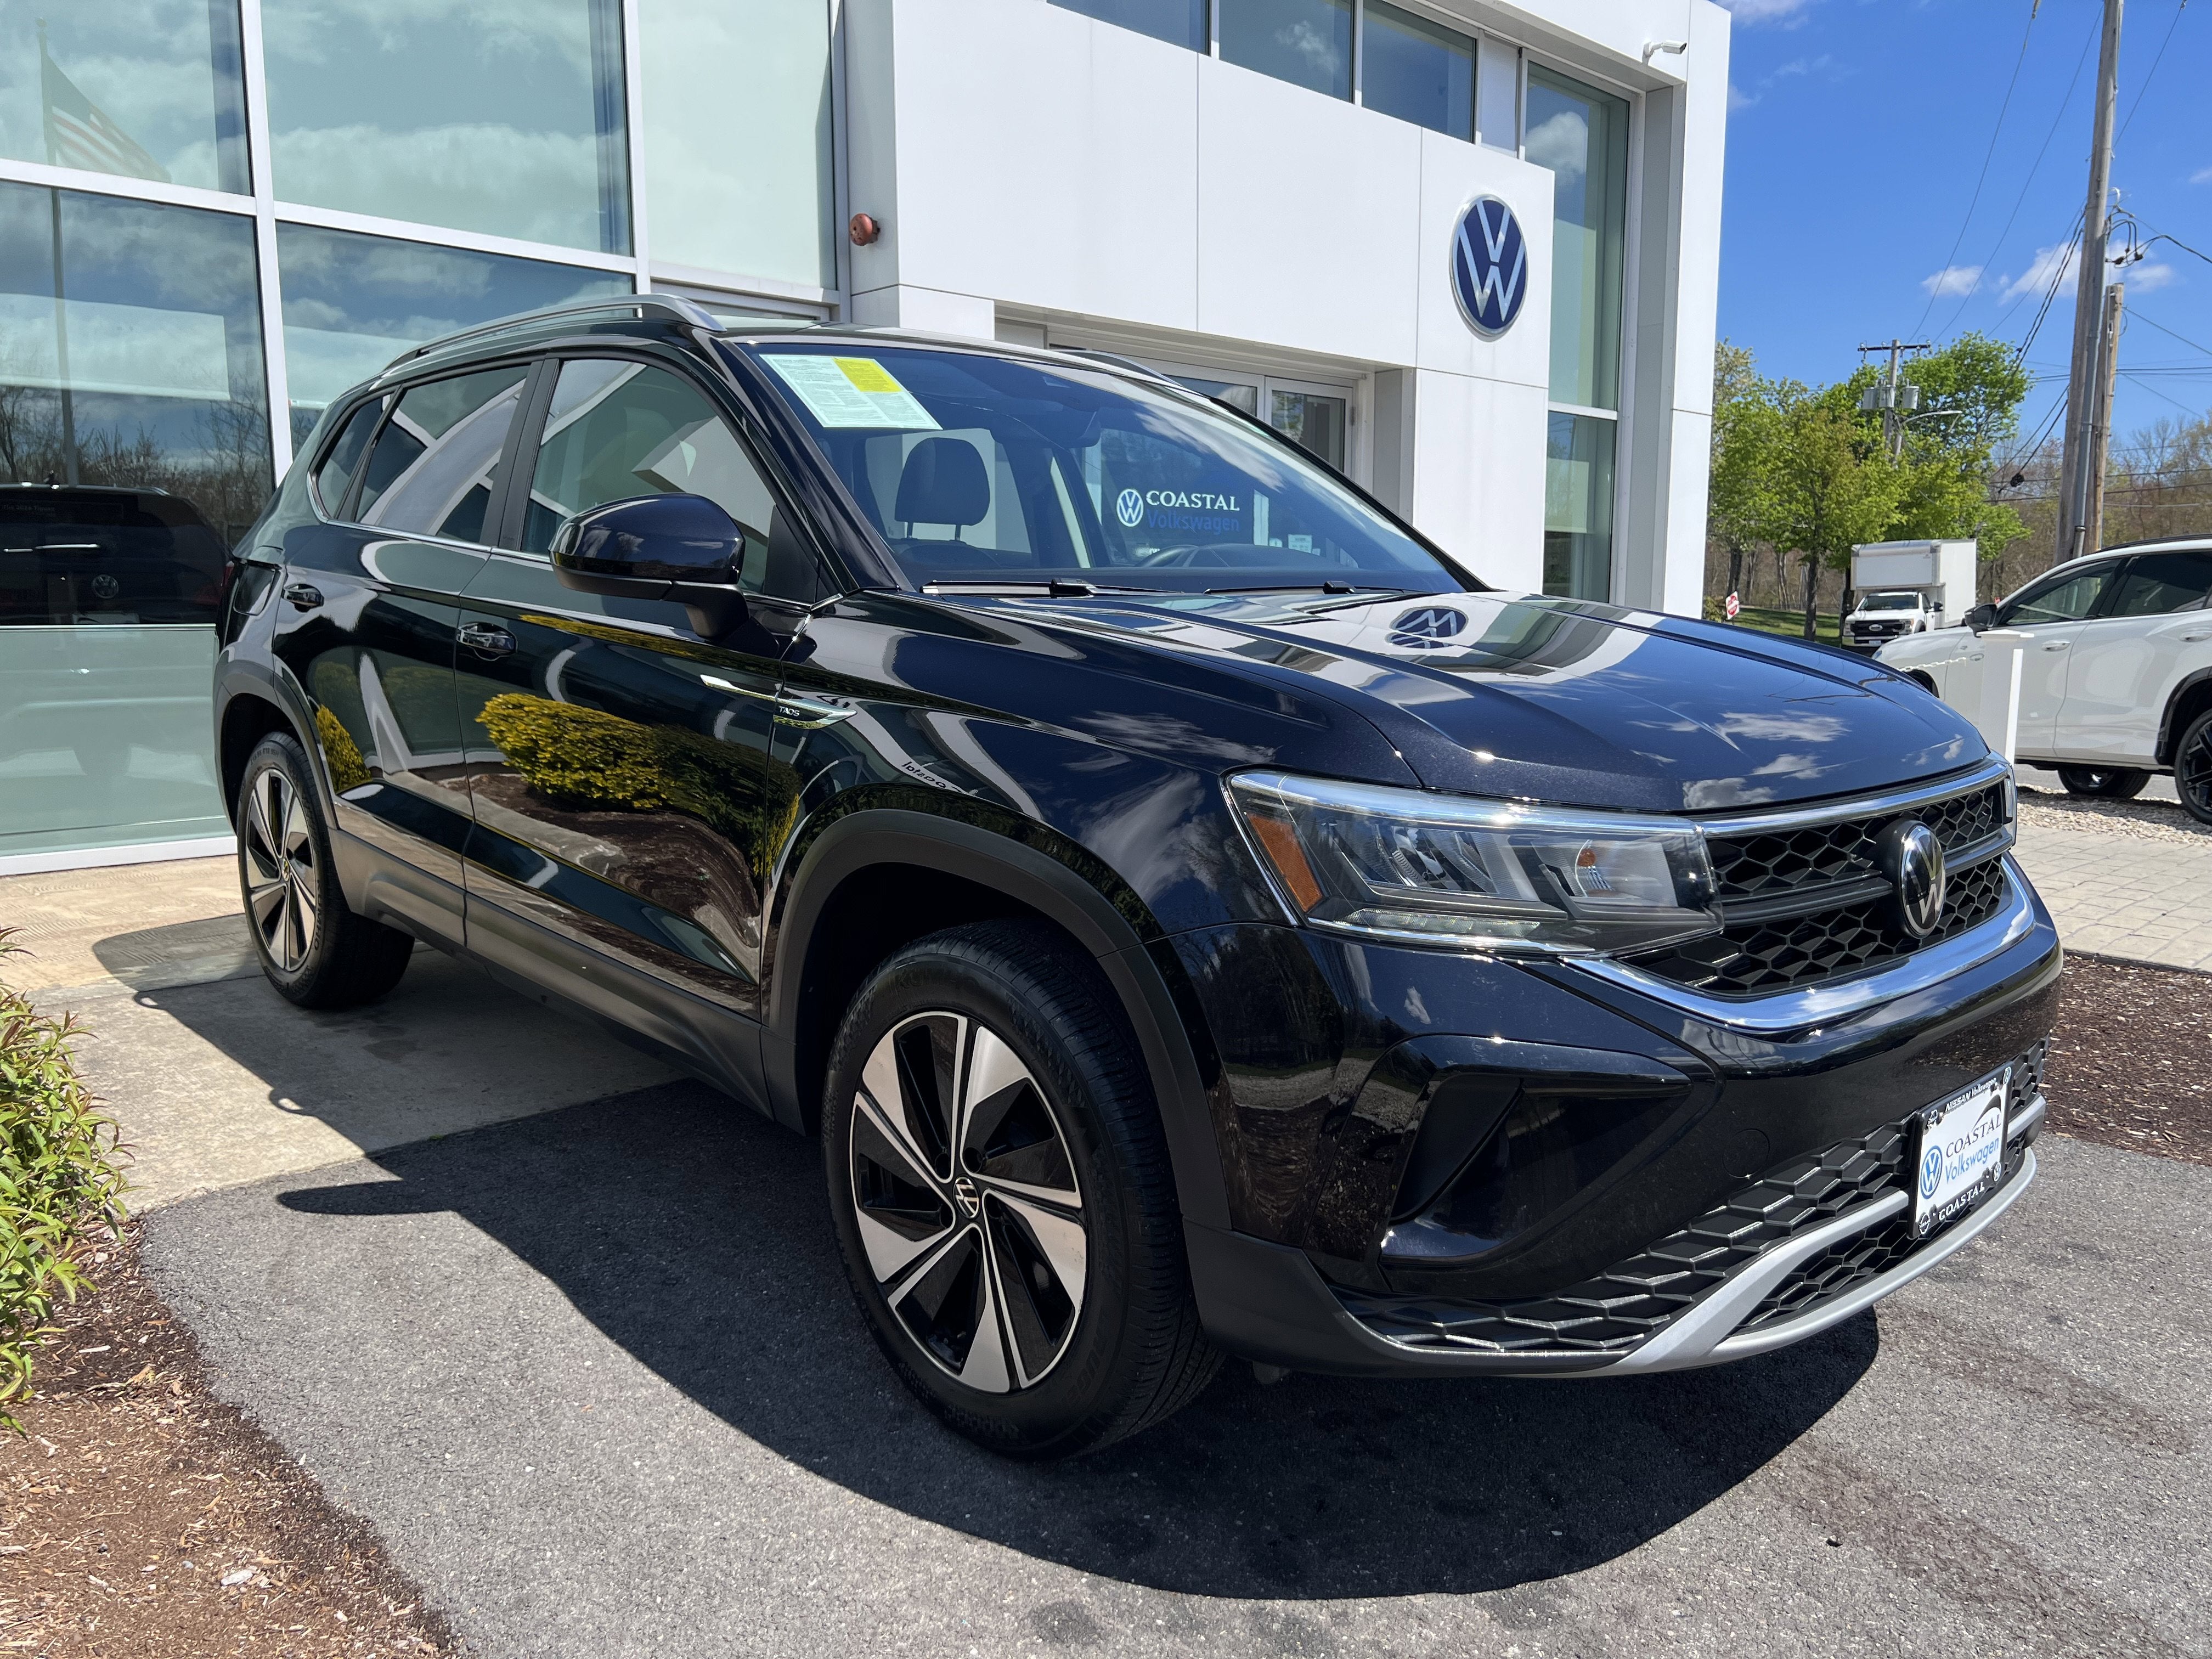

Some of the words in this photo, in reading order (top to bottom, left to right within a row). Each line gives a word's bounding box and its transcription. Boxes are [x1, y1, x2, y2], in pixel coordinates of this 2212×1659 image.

[1449, 194, 1528, 334] VW
[1116, 488, 1144, 527] VW
[1146, 490, 1240, 511] COASTAL
[1147, 509, 1239, 535] Volkswagen
[779, 706, 800, 717] TAOS
[1945, 1091, 1971, 1112] NISSAN
[1946, 1114, 2001, 1158] COASTAL
[1920, 1146, 1943, 1200] VW
[1945, 1137, 1999, 1183] Volkswagen
[1939, 1181, 1984, 1221] COASTAL
